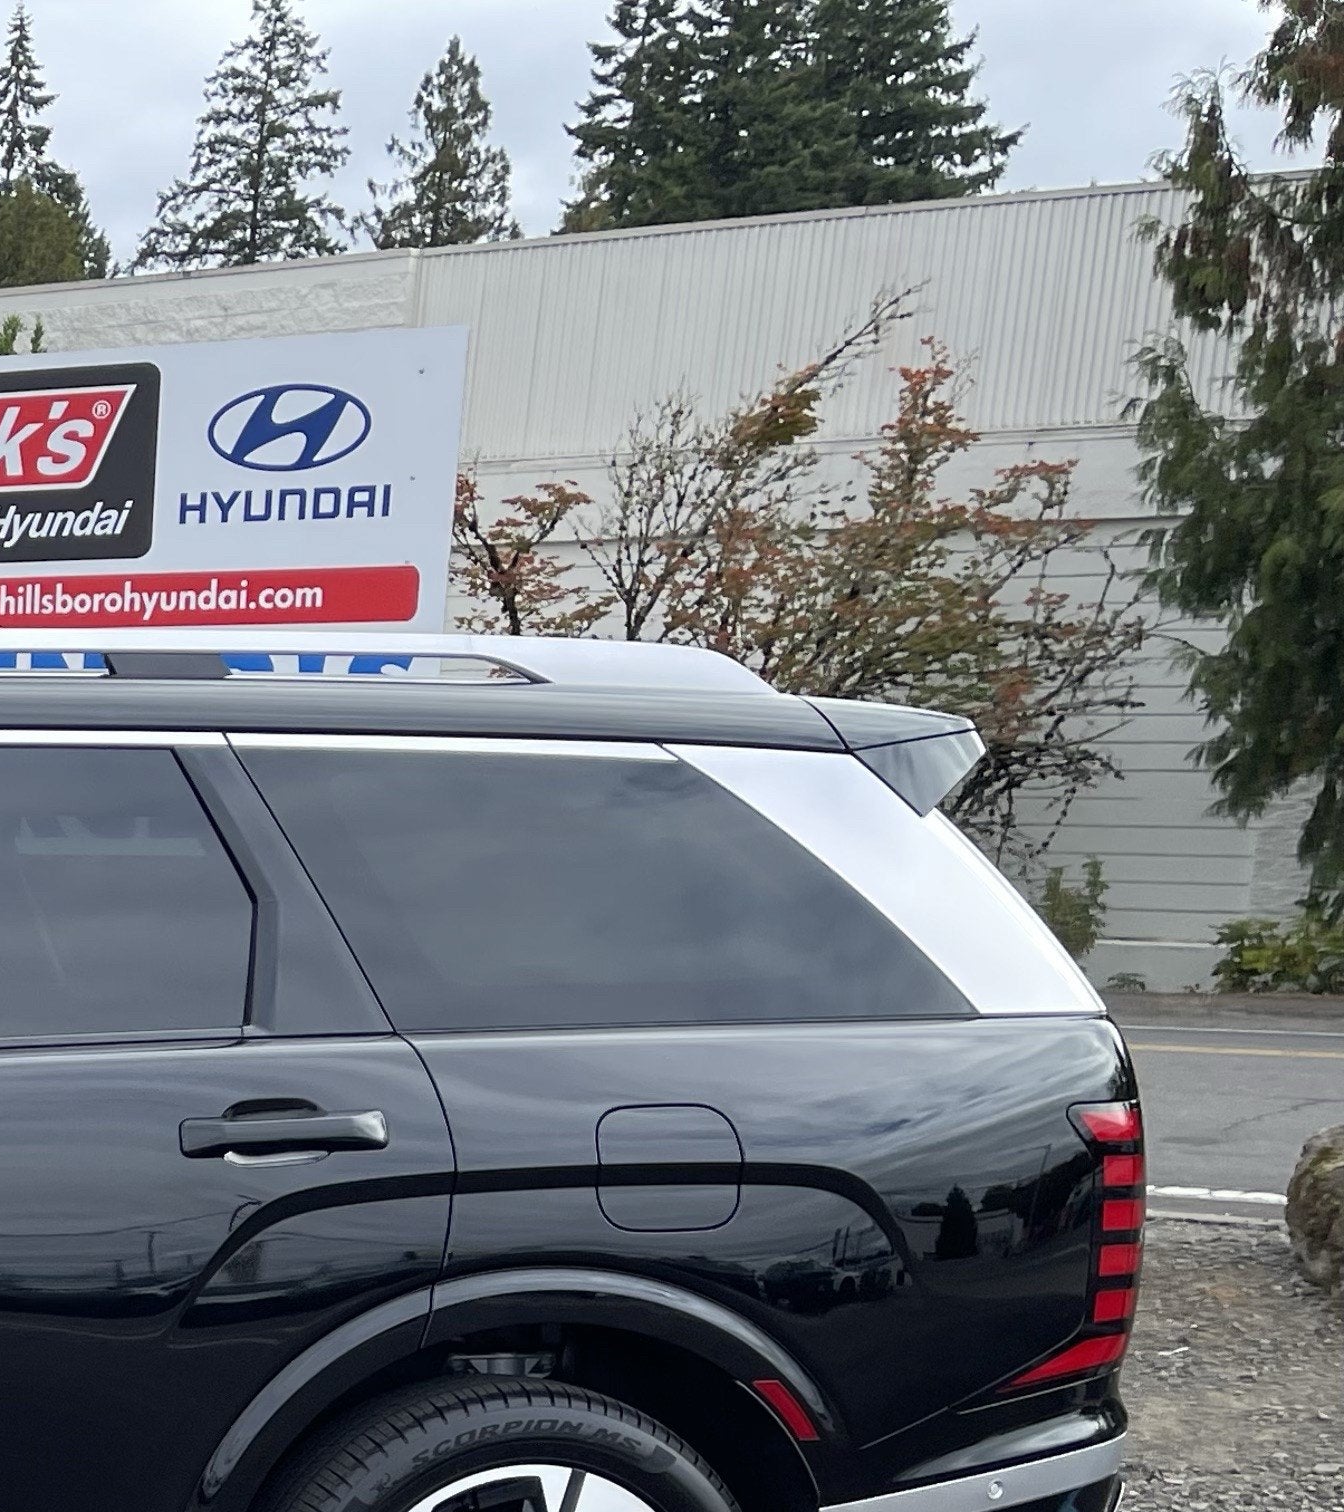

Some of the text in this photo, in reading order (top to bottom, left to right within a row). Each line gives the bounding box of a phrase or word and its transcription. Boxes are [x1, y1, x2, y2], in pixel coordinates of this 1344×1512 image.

[179, 484, 391, 524] HYUNDAI
[411, 1418, 643, 1470] SCORPION MS
